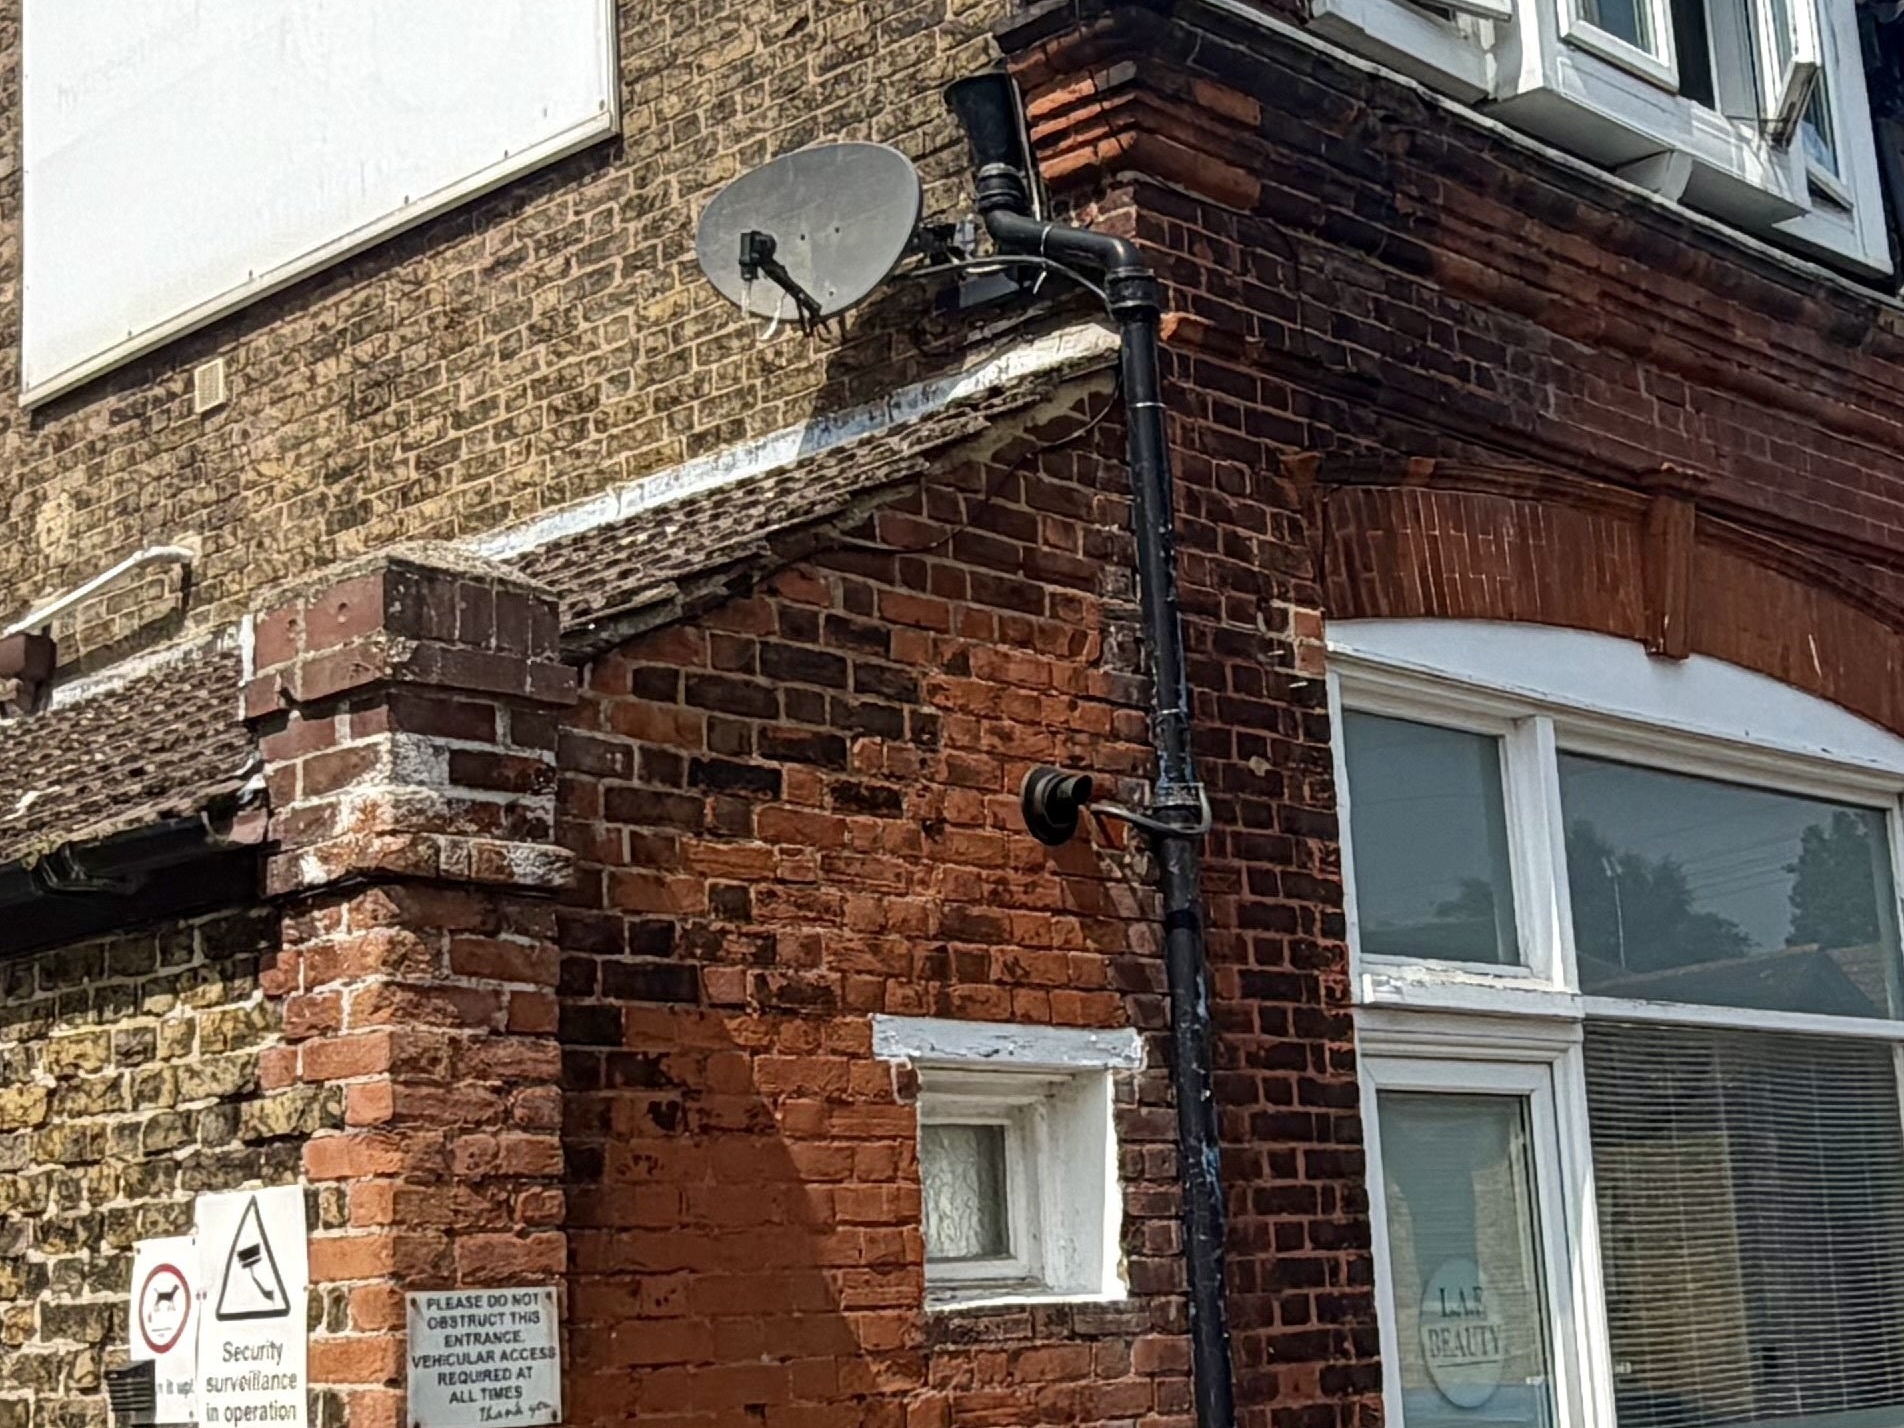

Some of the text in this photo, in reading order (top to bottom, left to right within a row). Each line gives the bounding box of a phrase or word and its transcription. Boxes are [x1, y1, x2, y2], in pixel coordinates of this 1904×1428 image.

[427, 1292, 540, 1311] PLEASE DO NOT
[427, 1310, 541, 1330] OBSTRUCT THIS
[222, 1339, 284, 1367] Security
[1427, 1325, 1500, 1359] BEAUTY
[412, 1346, 557, 1369] VEHICULAR ACCESS
[205, 1369, 299, 1394] surveillance
[437, 1365, 534, 1387] REQUIRED AT
[448, 1384, 524, 1405] ALL TIMES
[205, 1399, 297, 1428] in operation
